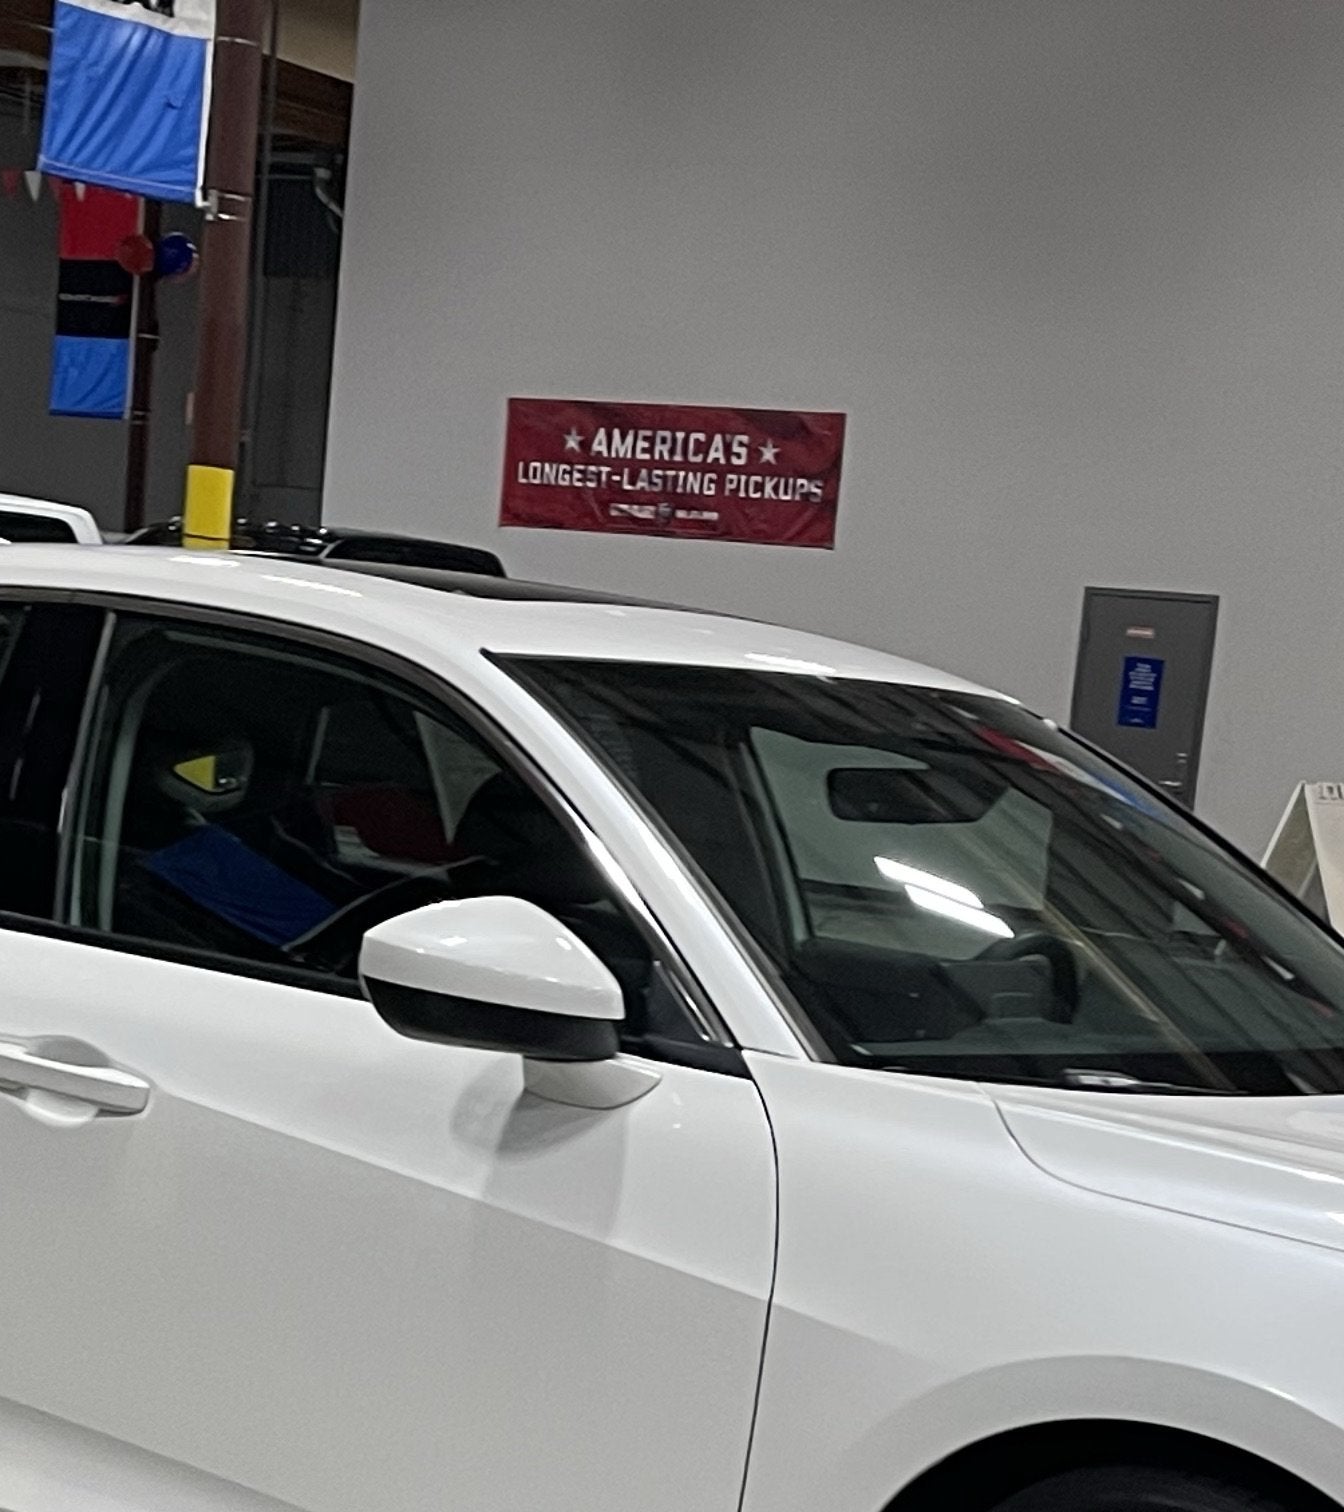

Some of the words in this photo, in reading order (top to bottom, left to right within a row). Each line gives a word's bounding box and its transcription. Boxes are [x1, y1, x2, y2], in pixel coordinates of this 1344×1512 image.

[590, 427, 749, 466] AMERICA'S
[517, 461, 716, 497] LONGEST-LASTING
[723, 474, 824, 502] PICKUPS
